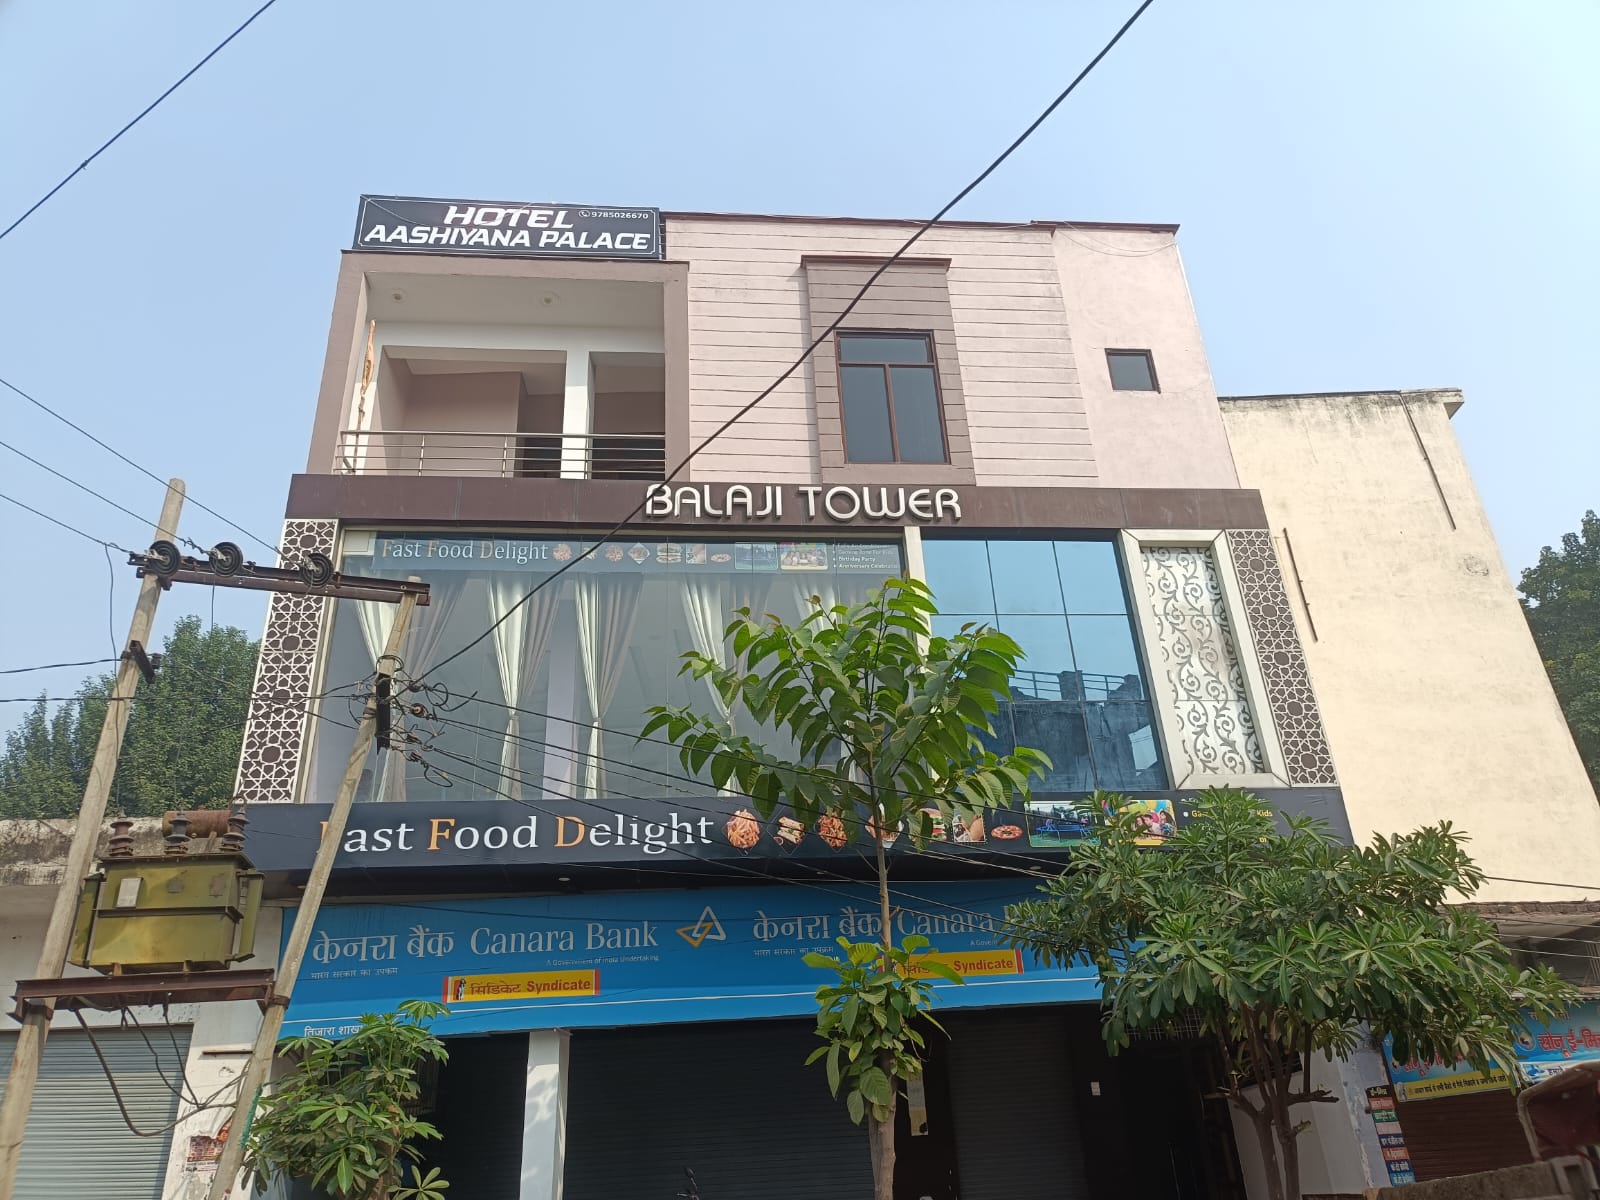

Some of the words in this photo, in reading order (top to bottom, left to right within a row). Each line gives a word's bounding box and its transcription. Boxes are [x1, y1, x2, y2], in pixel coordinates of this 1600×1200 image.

[443, 206, 574, 229] HOTEL
[364, 224, 531, 247] AASHIYANA
[538, 230, 651, 249] PALACE
[646, 483, 782, 518] BALAJI
[798, 486, 962, 520] TOWER
[382, 540, 422, 558] Fast
[426, 540, 474, 558] Food
[480, 540, 548, 564] Delight
[427, 815, 539, 851] Food
[554, 812, 713, 855] Delight
[752, 908, 831, 942] केनरा
[838, 905, 882, 938] बैंक
[897, 908, 994, 936] Canara
[312, 930, 398, 964] केनरा
[407, 924, 455, 958] बैंक
[470, 926, 575, 956] Canara
[585, 920, 659, 951] Bank
[620, 954, 659, 963] Undertaking
[954, 959, 1013, 974] Syndicate
[526, 979, 591, 995] Syndicate
